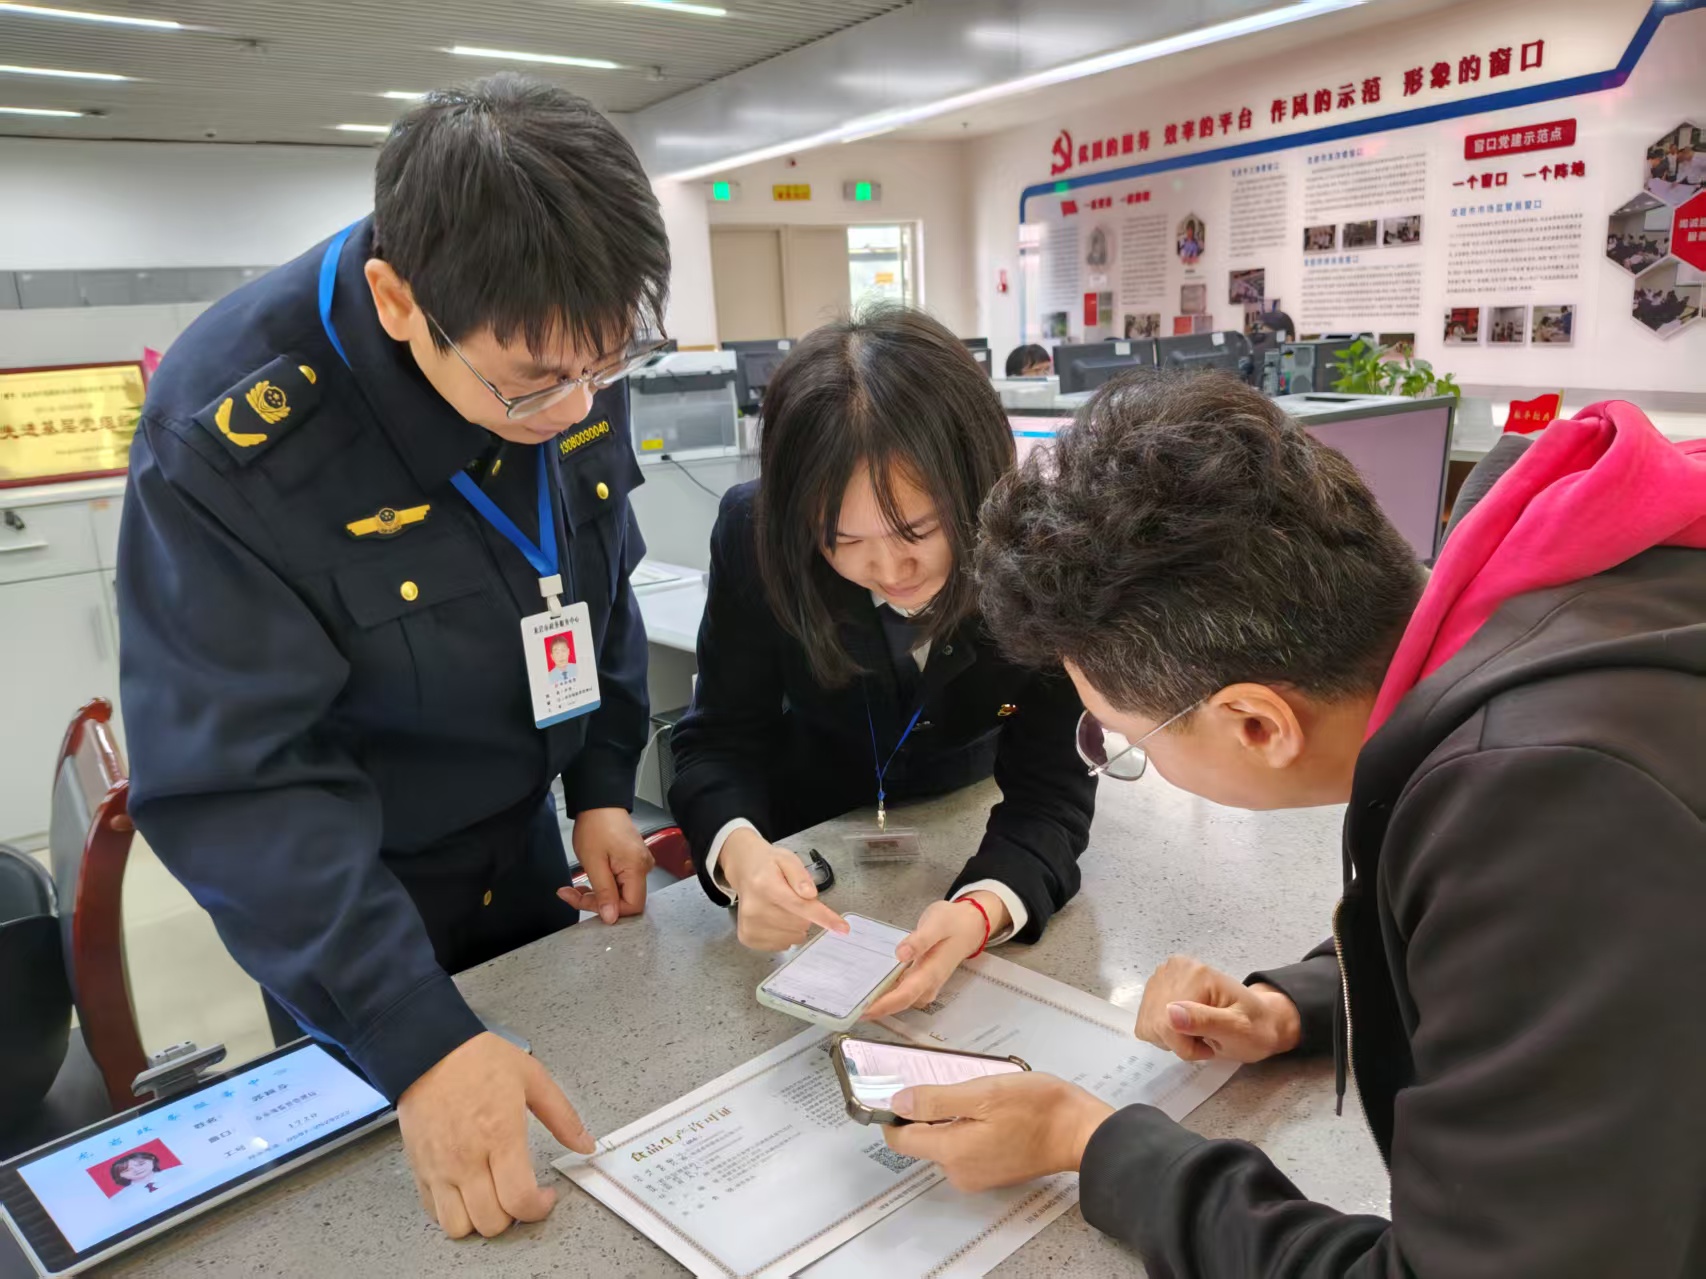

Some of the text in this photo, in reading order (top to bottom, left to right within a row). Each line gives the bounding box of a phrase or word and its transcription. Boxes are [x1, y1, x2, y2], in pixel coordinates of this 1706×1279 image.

[1164, 106, 1252, 145] 效率的平台
[1270, 76, 1381, 123] 作风的示范
[1403, 39, 1544, 97] 形象的窗口
[1474, 126, 1562, 153] 窗口党建示范点
[1452, 171, 1508, 190] 一个窗口
[631, 1105, 732, 1163] 食品生产许可证
